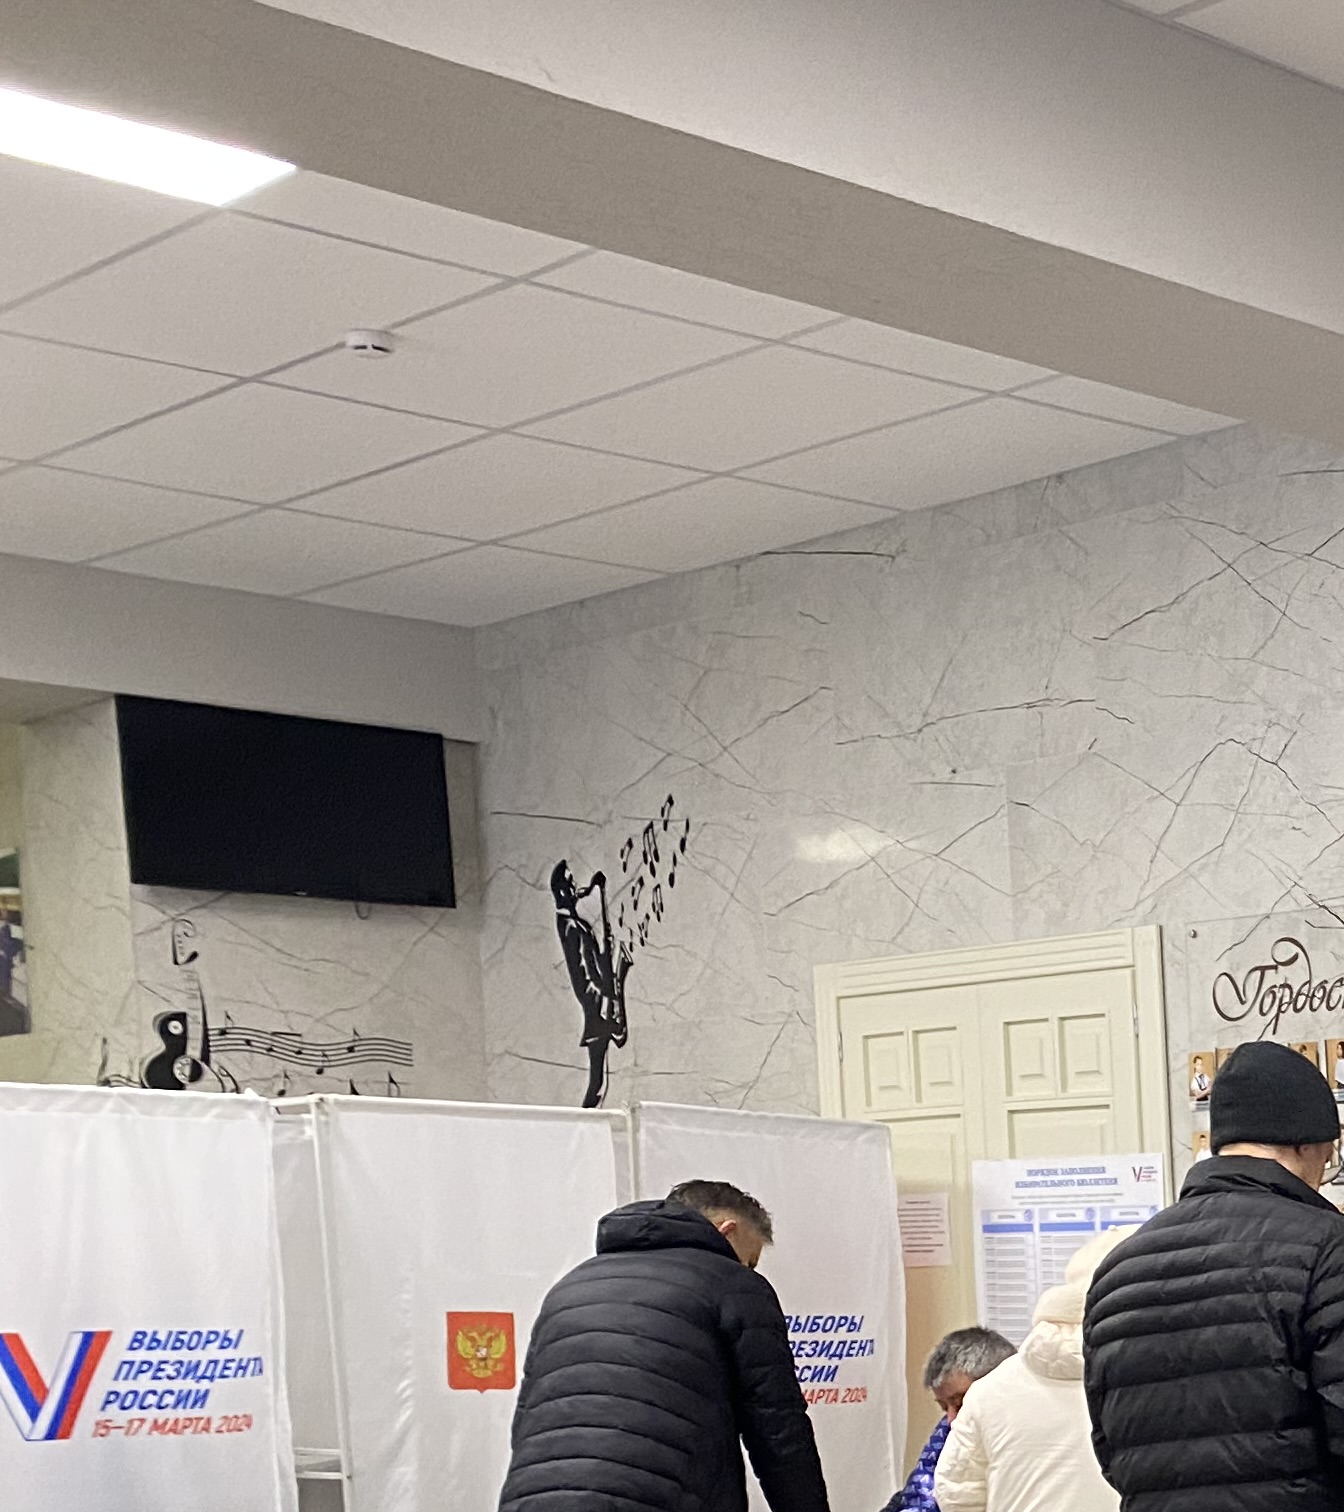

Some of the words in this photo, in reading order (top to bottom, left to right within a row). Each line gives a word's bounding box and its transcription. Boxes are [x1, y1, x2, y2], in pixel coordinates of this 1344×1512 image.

[127, 1329, 245, 1351] ВЫБОРЫ
[100, 1389, 211, 1412] РОССИИ
[149, 1416, 211, 1435] МАРТА
